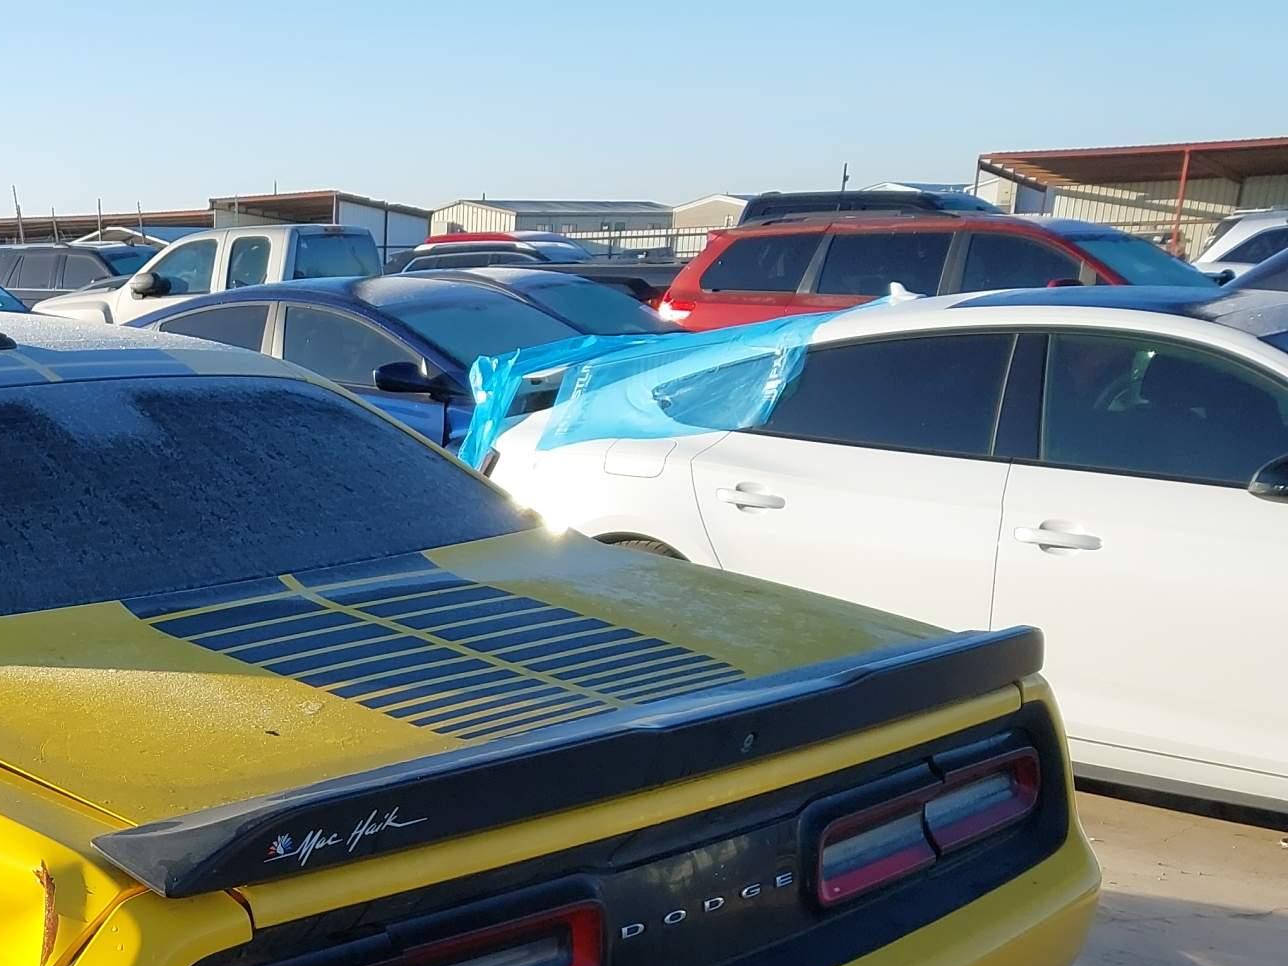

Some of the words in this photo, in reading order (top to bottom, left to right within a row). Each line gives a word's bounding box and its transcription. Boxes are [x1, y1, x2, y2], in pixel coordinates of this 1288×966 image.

[264, 829, 344, 867] Mac
[346, 806, 428, 853] Haik
[621, 872, 793, 940] DODGE
